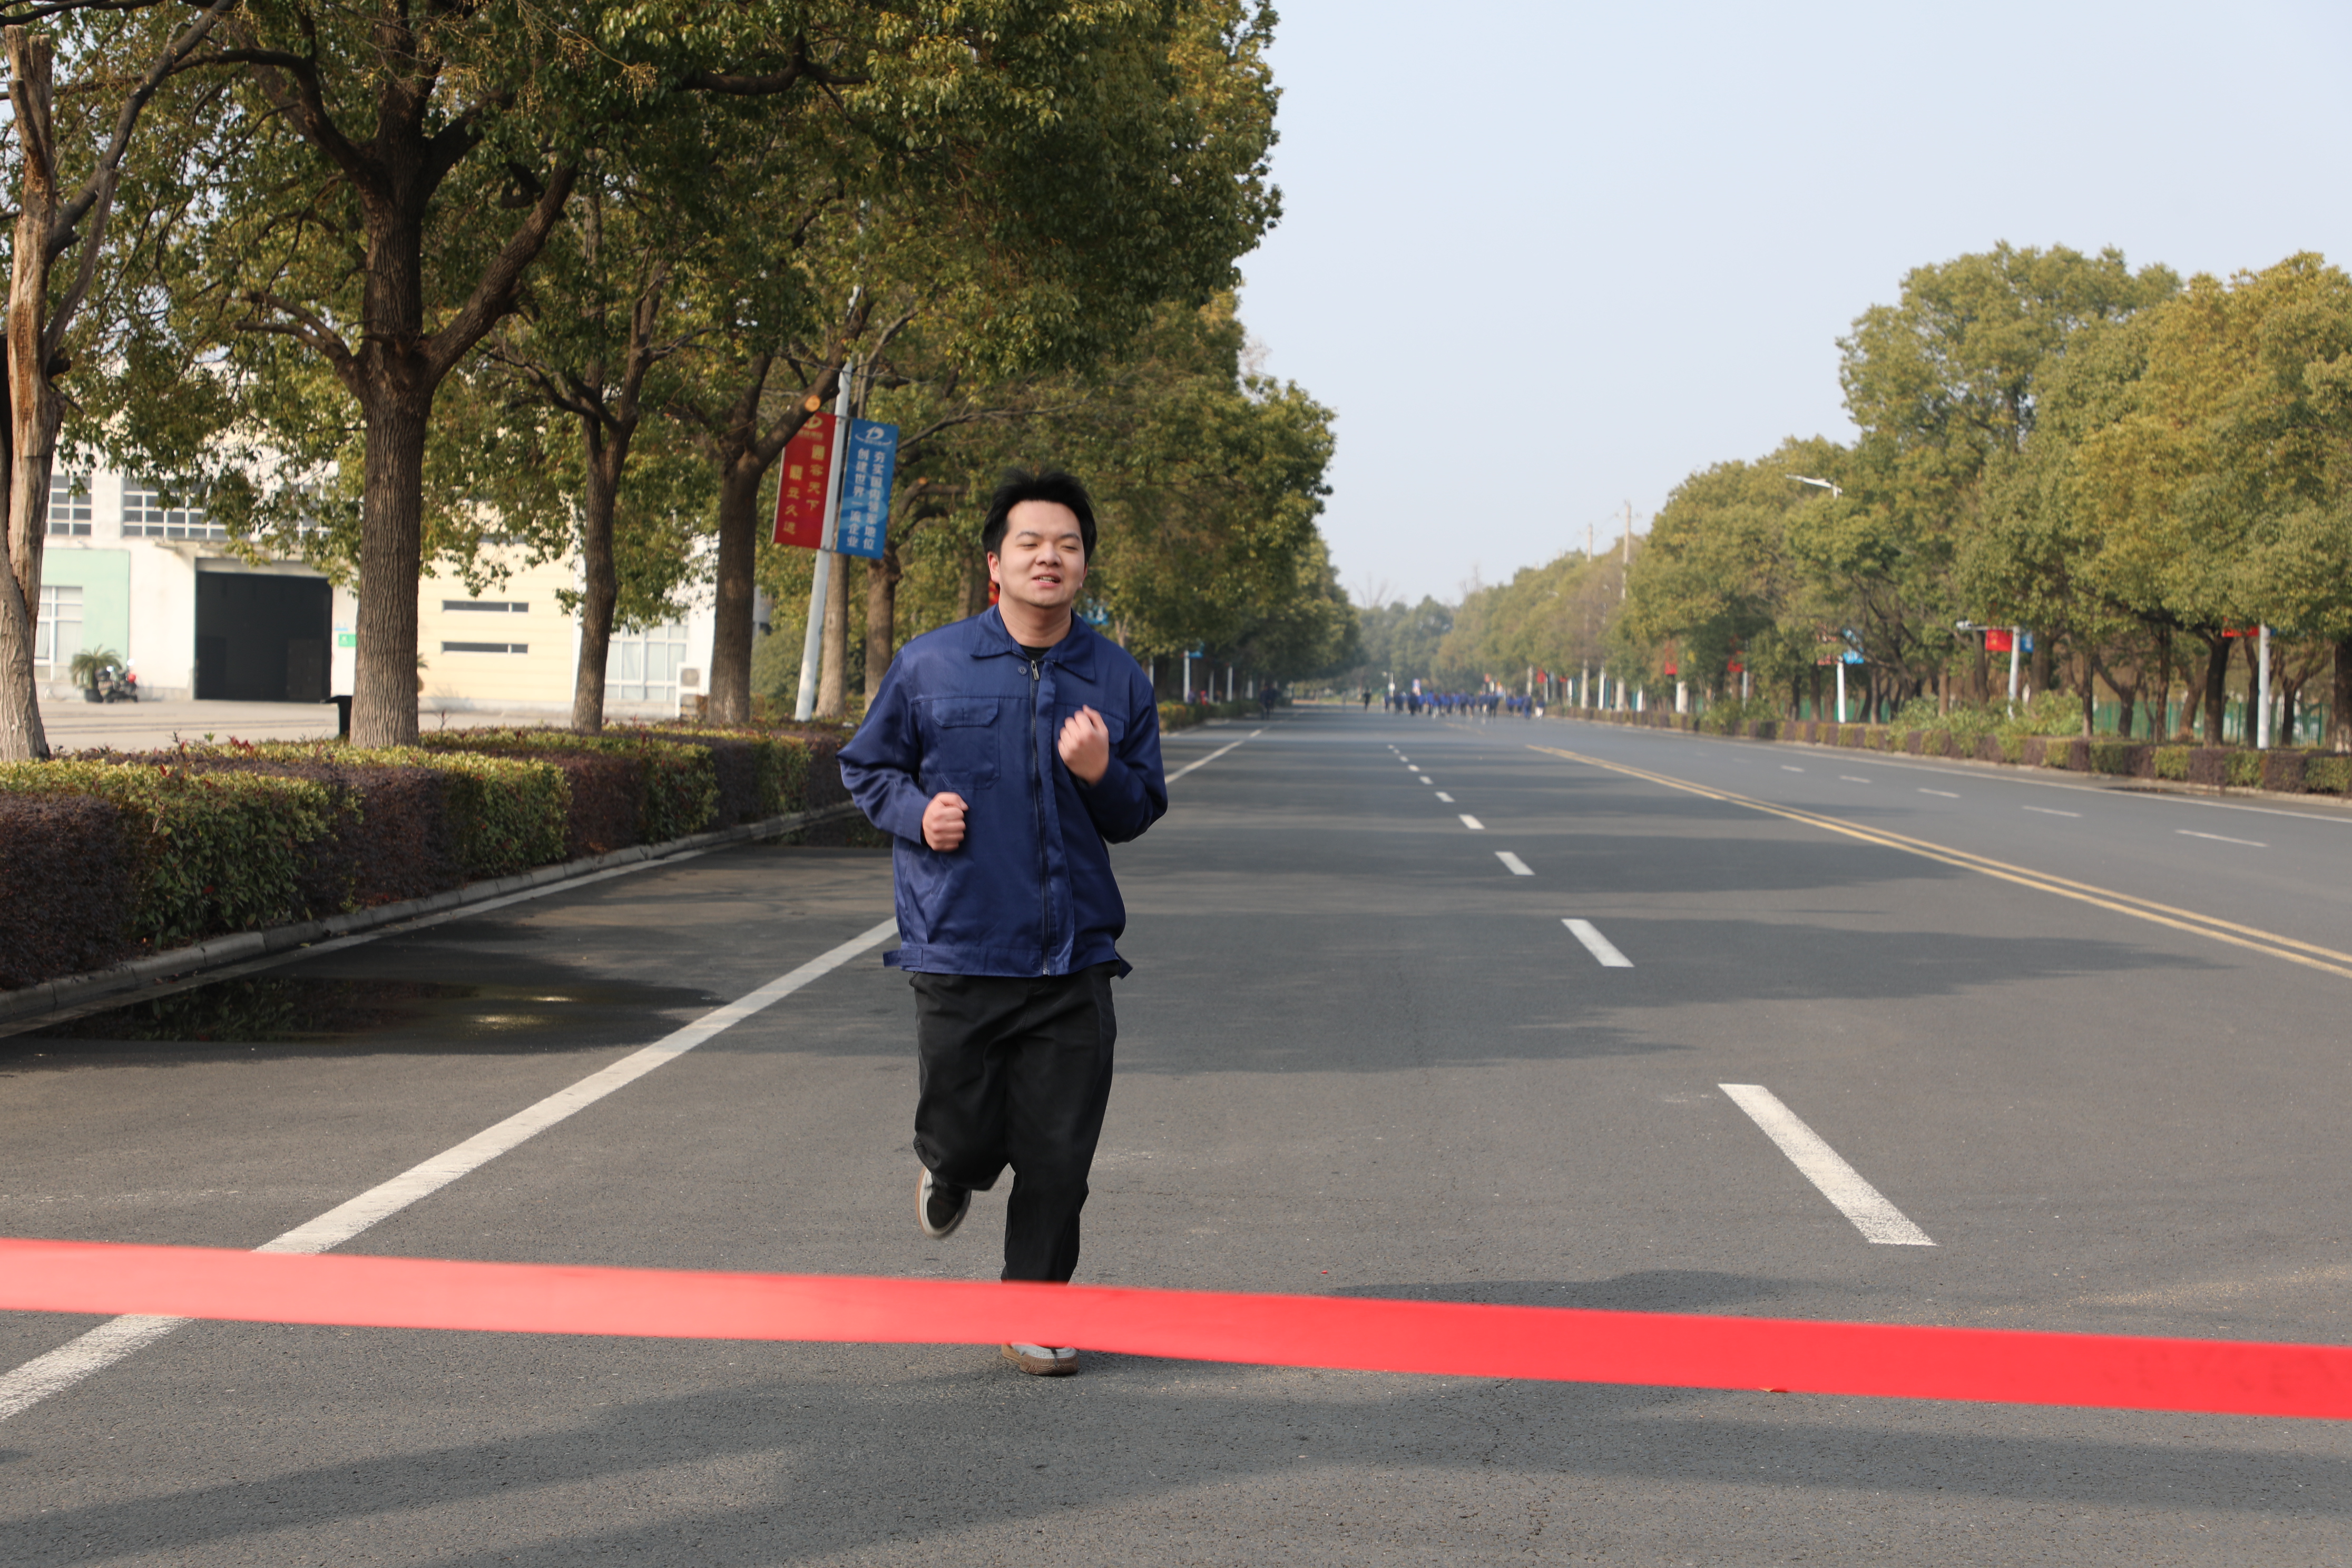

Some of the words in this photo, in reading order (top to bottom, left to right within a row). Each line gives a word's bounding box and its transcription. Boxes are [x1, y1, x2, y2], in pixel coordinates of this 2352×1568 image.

[847, 448, 869, 547] 创建世界一流企业
[863, 450, 885, 550] 夯实国内领军地位
